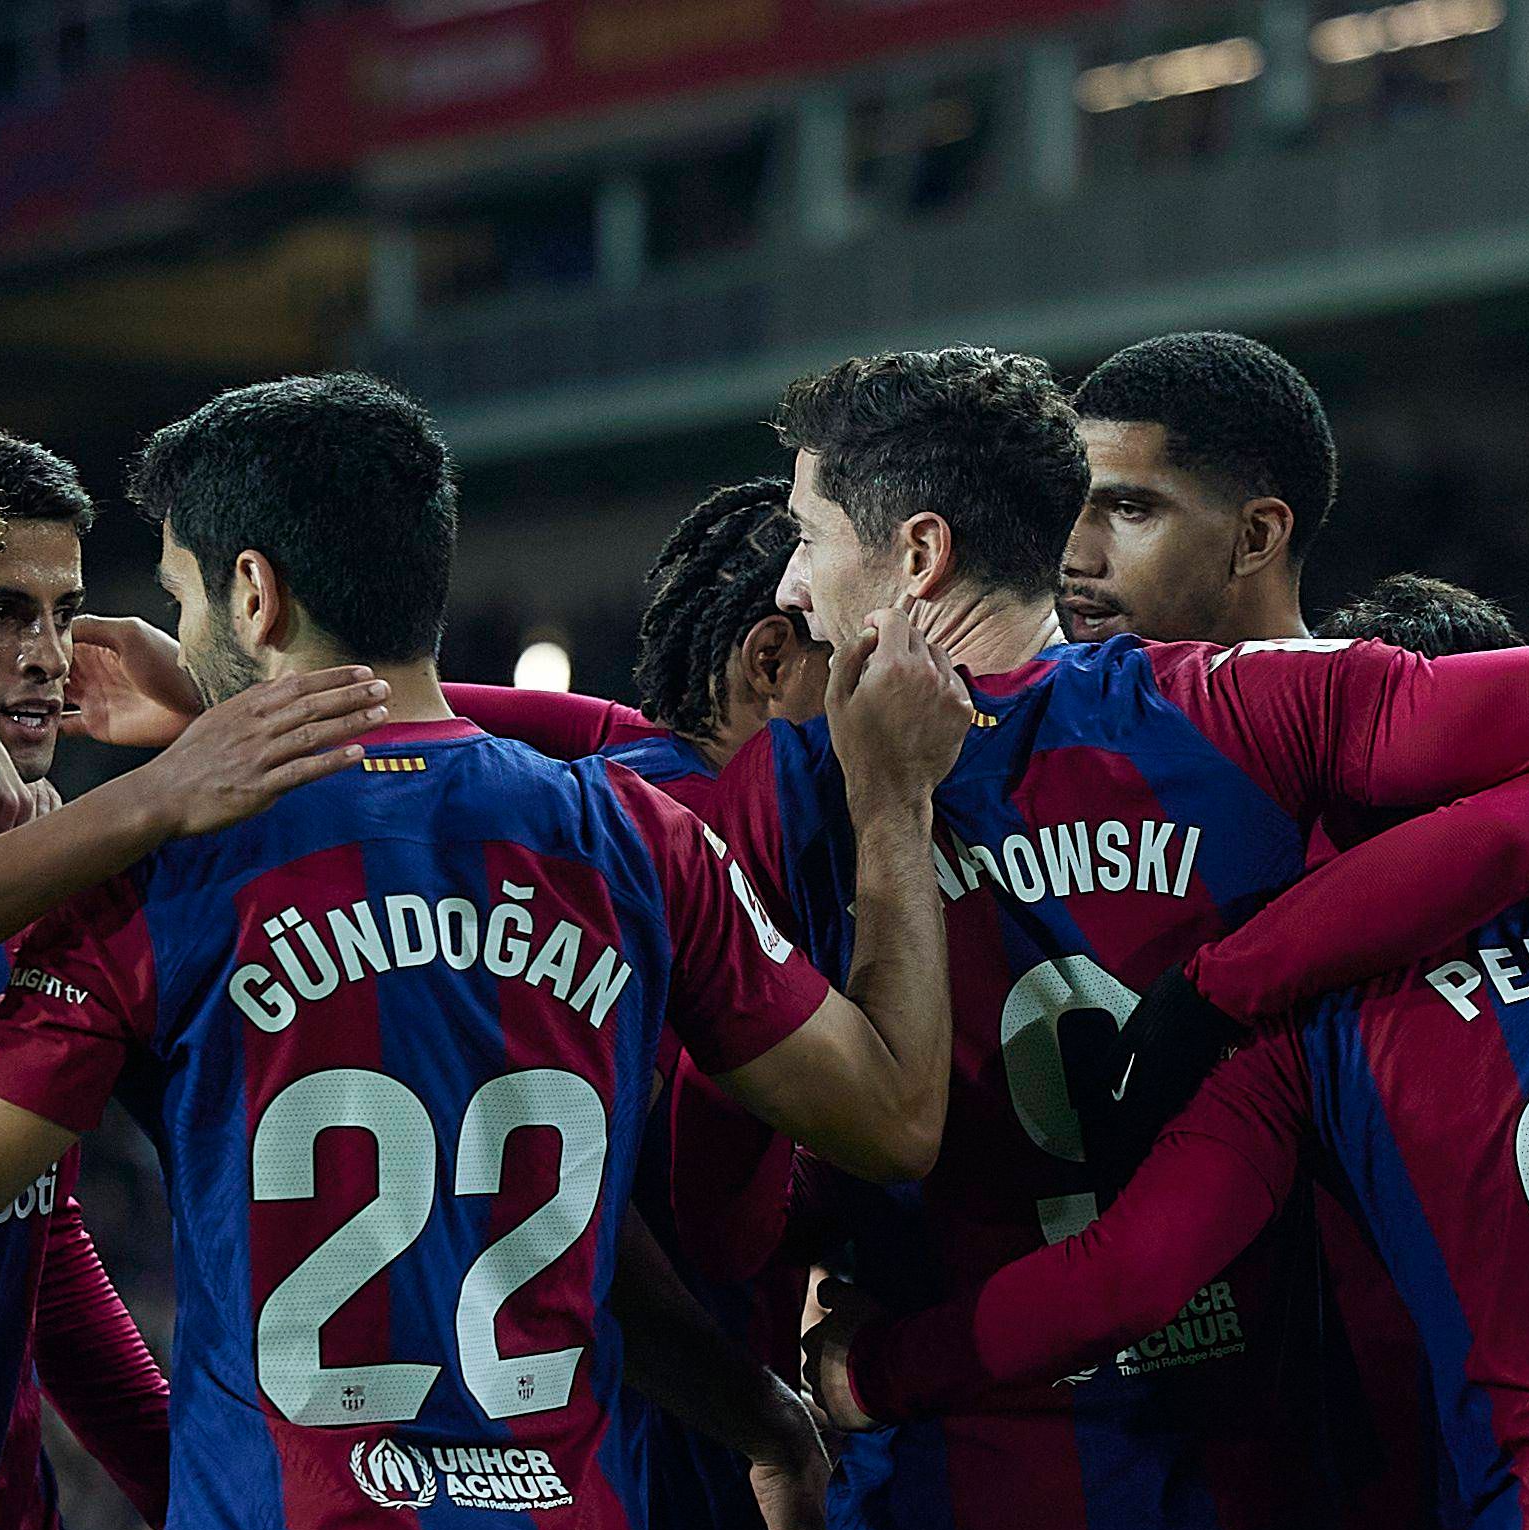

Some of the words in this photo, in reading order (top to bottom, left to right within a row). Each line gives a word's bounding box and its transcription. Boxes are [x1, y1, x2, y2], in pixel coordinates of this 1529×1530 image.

[932, 819, 1201, 903] NDOWSKI
[228, 879, 633, 1034] GÜNDOĞAN
[65, 984, 89, 1005] tv
[252, 1067, 608, 1427] 22
[1118, 1364, 1141, 1377] The
[1141, 1359, 1161, 1373] UN
[1162, 1351, 1208, 1368] Refugee
[1208, 1342, 1246, 1359] Agency
[432, 1447, 557, 1475] UNHCR
[446, 1474, 570, 1500] ACNUR
[451, 1496, 473, 1508] The
[490, 1499, 533, 1512] Refugee
[533, 1495, 574, 1510] Agency
